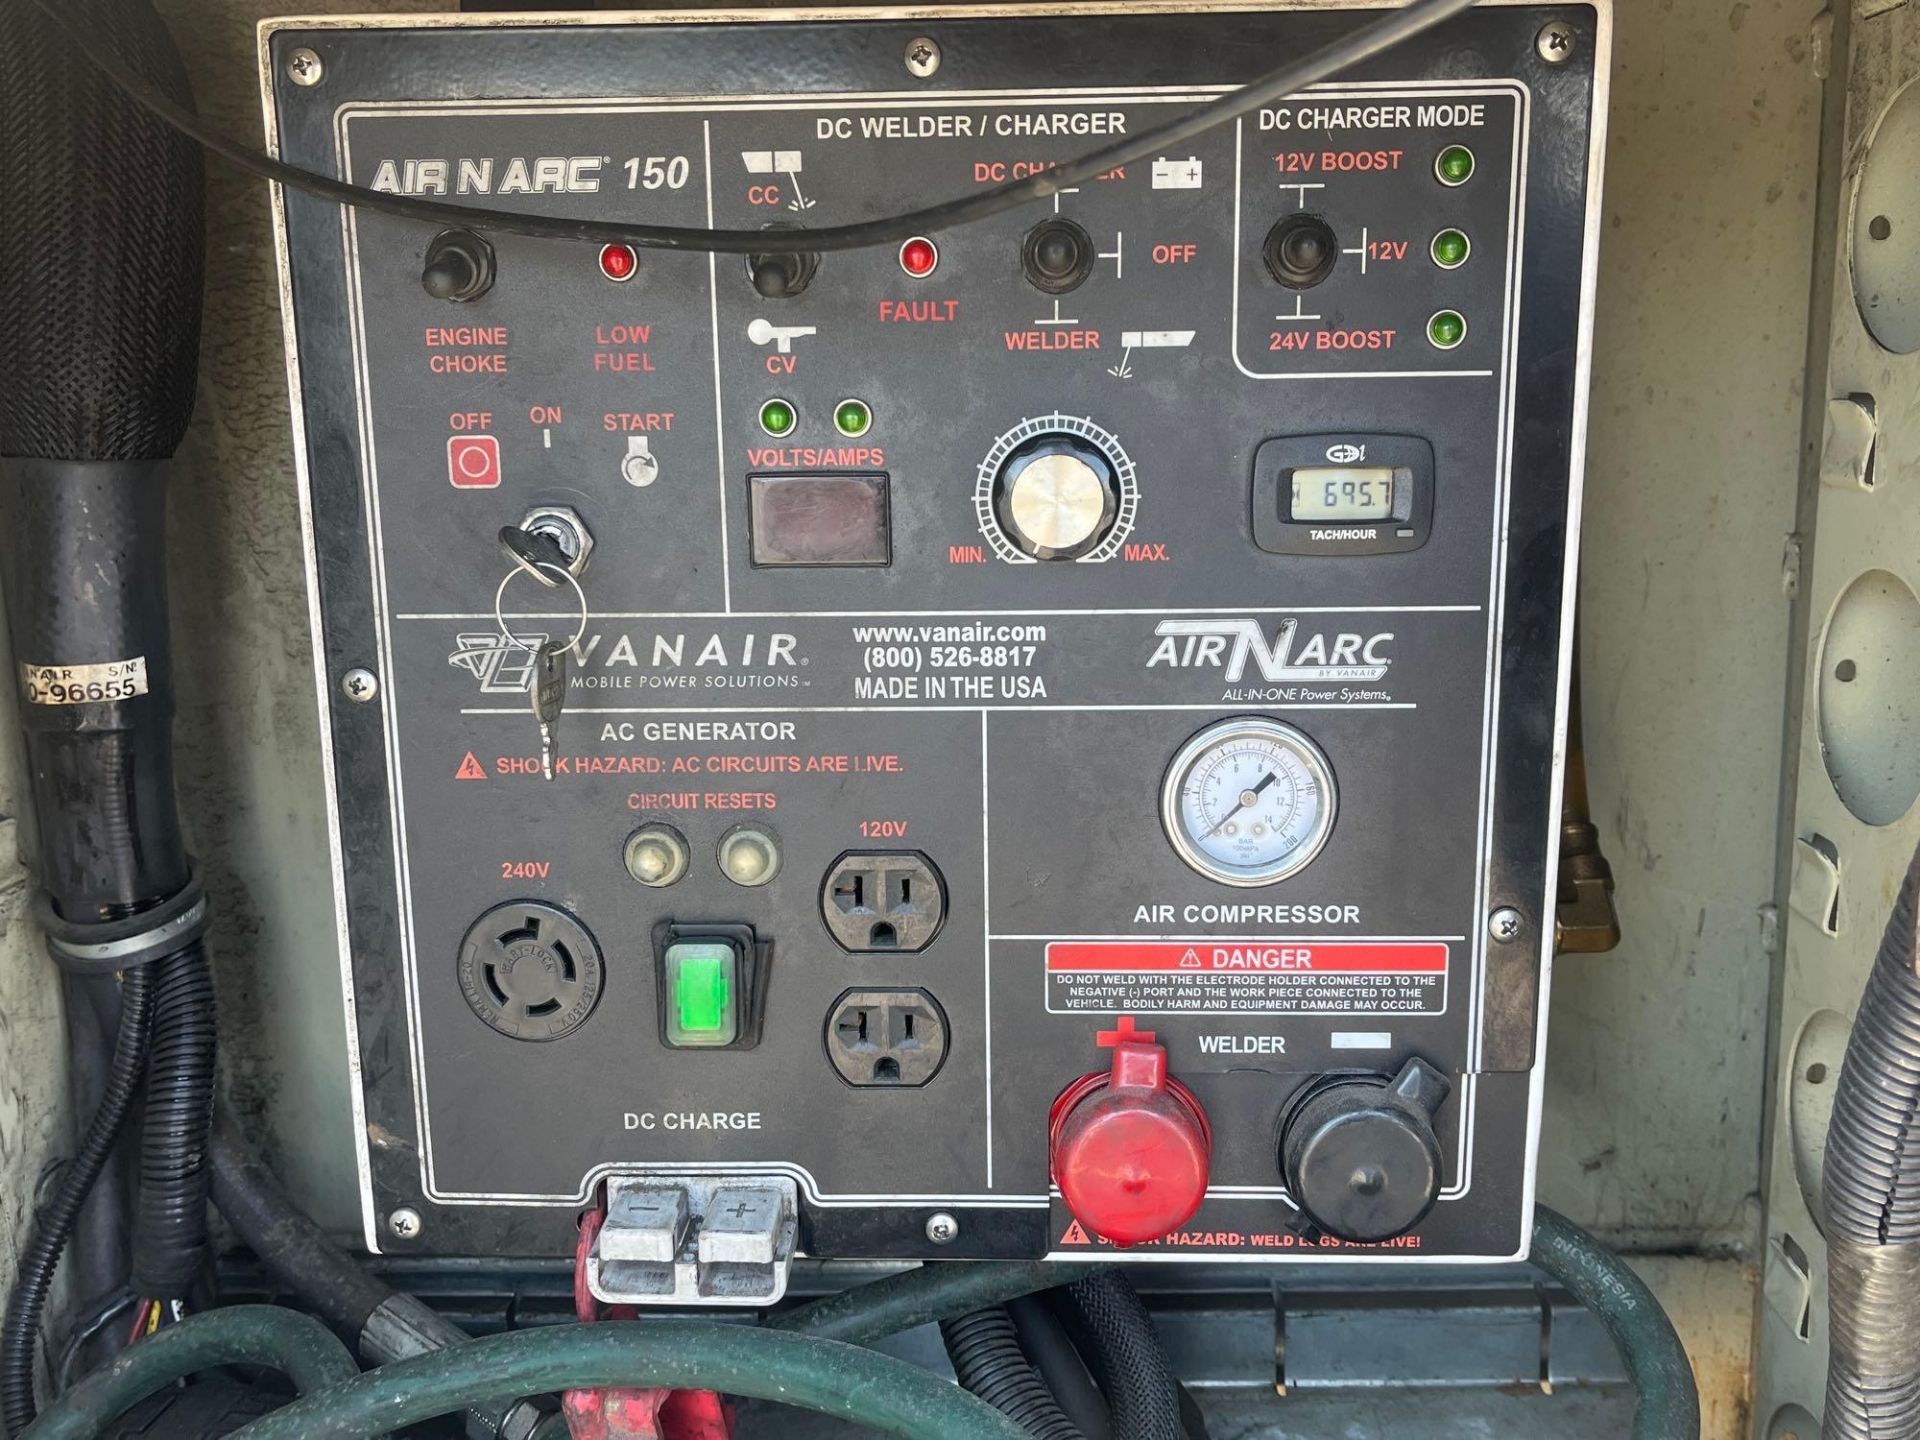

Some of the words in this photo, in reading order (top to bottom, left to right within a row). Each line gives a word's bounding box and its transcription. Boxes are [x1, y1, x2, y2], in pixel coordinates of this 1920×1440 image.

[817, 118, 851, 139] DC
[860, 116, 972, 138] WELDER
[980, 115, 987, 136] /
[995, 113, 1126, 135] CHARGER
[1260, 109, 1290, 130] DC
[1298, 107, 1410, 129] CHARGER
[1418, 105, 1484, 127] MODE
[1275, 152, 1315, 173] 12V
[1321, 149, 1402, 171] BOOST
[370, 159, 449, 195] AIR
[457, 158, 493, 194] N
[498, 156, 602, 194] ARC
[625, 156, 689, 189] 150
[975, 162, 1005, 182] DC
[747, 185, 779, 205] CC
[1152, 243, 1197, 265] OFF
[1369, 240, 1408, 260] 12V
[880, 300, 959, 321] FAULT
[426, 326, 505, 347] ENGINE
[596, 325, 650, 344] LOW
[1004, 330, 1100, 350] WELDER
[1270, 331, 1310, 351] 24V
[1315, 329, 1395, 351] BOOST
[430, 353, 506, 374] CHOKE
[593, 351, 655, 373] FUEL
[767, 355, 797, 374] CV
[450, 412, 492, 430] OFF
[529, 405, 563, 425] ON
[604, 412, 673, 431] START
[748, 448, 884, 467] VOLTS/AMPS
[1310, 530, 1376, 540] TACH/HOUR
[949, 546, 986, 563] MIN.
[1125, 544, 1170, 561] MAX.
[853, 622, 1045, 644] www.vanair.com
[568, 633, 796, 666] VANAIR
[865, 647, 921, 674] (800)
[931, 645, 1036, 667] 526-8817
[571, 676, 632, 688] MOBILE
[640, 676, 696, 687] POWER
[705, 675, 798, 687] SOLUTIONS
[1336, 669, 1377, 677] VANAIR
[855, 677, 918, 698] MADE
[926, 677, 947, 698] IN
[950, 677, 993, 698] THE
[1002, 676, 1047, 698] USA
[1222, 688, 1297, 700] ALL-IN-ONE
[1301, 688, 1337, 700] Power
[601, 723, 634, 741] AC
[644, 722, 795, 740] GENERATOR
[496, 757, 571, 774] SHOK
[575, 756, 666, 773] HAZARD:
[672, 757, 700, 772] AC
[707, 755, 802, 773] CIRCUITS
[806, 755, 848, 773] ARE
[855, 754, 904, 772] LIVE.
[628, 793, 700, 809] CIRCUIT
[704, 792, 776, 810] RESETS
[861, 820, 907, 838] 120V
[501, 861, 550, 880] 240V
[1134, 905, 1175, 922] AIR
[1184, 905, 1359, 923] COMPRESSOR
[1211, 947, 1313, 970] DANGER
[1057, 975, 1073, 984] DO
[1077, 975, 1099, 984] NOT
[1103, 974, 1135, 984] WELD
[1139, 974, 1167, 984] WITH
[1172, 974, 1192, 984] THE
[1197, 974, 1265, 984] ELECTRODE
[1269, 976, 1316, 985] HOLDER
[1320, 975, 1391, 985] CONNECTED
[1395, 975, 1410, 985] TO
[1413, 975, 1435, 985] THE
[1070, 987, 1125, 996] NEGATIVE
[1129, 988, 1140, 999] (-)
[1144, 988, 1174, 996] PORT
[1177, 988, 1201, 996] AND
[1205, 988, 1226, 996] THE
[1230, 988, 1265, 997] WORK
[1269, 988, 1302, 997] PIECE
[1306, 988, 1377, 997] CONNECTED
[1381, 989, 1396, 997] TO
[1400, 989, 1421, 997] THE
[1124, 998, 1164, 1008] BODILY
[1168, 1000, 1200, 1008] HARM
[1203, 1000, 1227, 1008] AND
[1231, 1000, 1297, 1011] EQUIPMENT
[1301, 1000, 1350, 1009] DAMAGE
[1354, 1001, 1378, 1009] MAY
[1381, 1001, 1425, 1009] OCCUR.
[1199, 1036, 1285, 1053] WELDER
[624, 1113, 655, 1129] DC
[664, 1113, 761, 1129] CHARGE
[1165, 1230, 1245, 1246] HAZARD:
[1251, 1235, 1293, 1246] WELD
[1297, 1236, 1340, 1247] LGS
